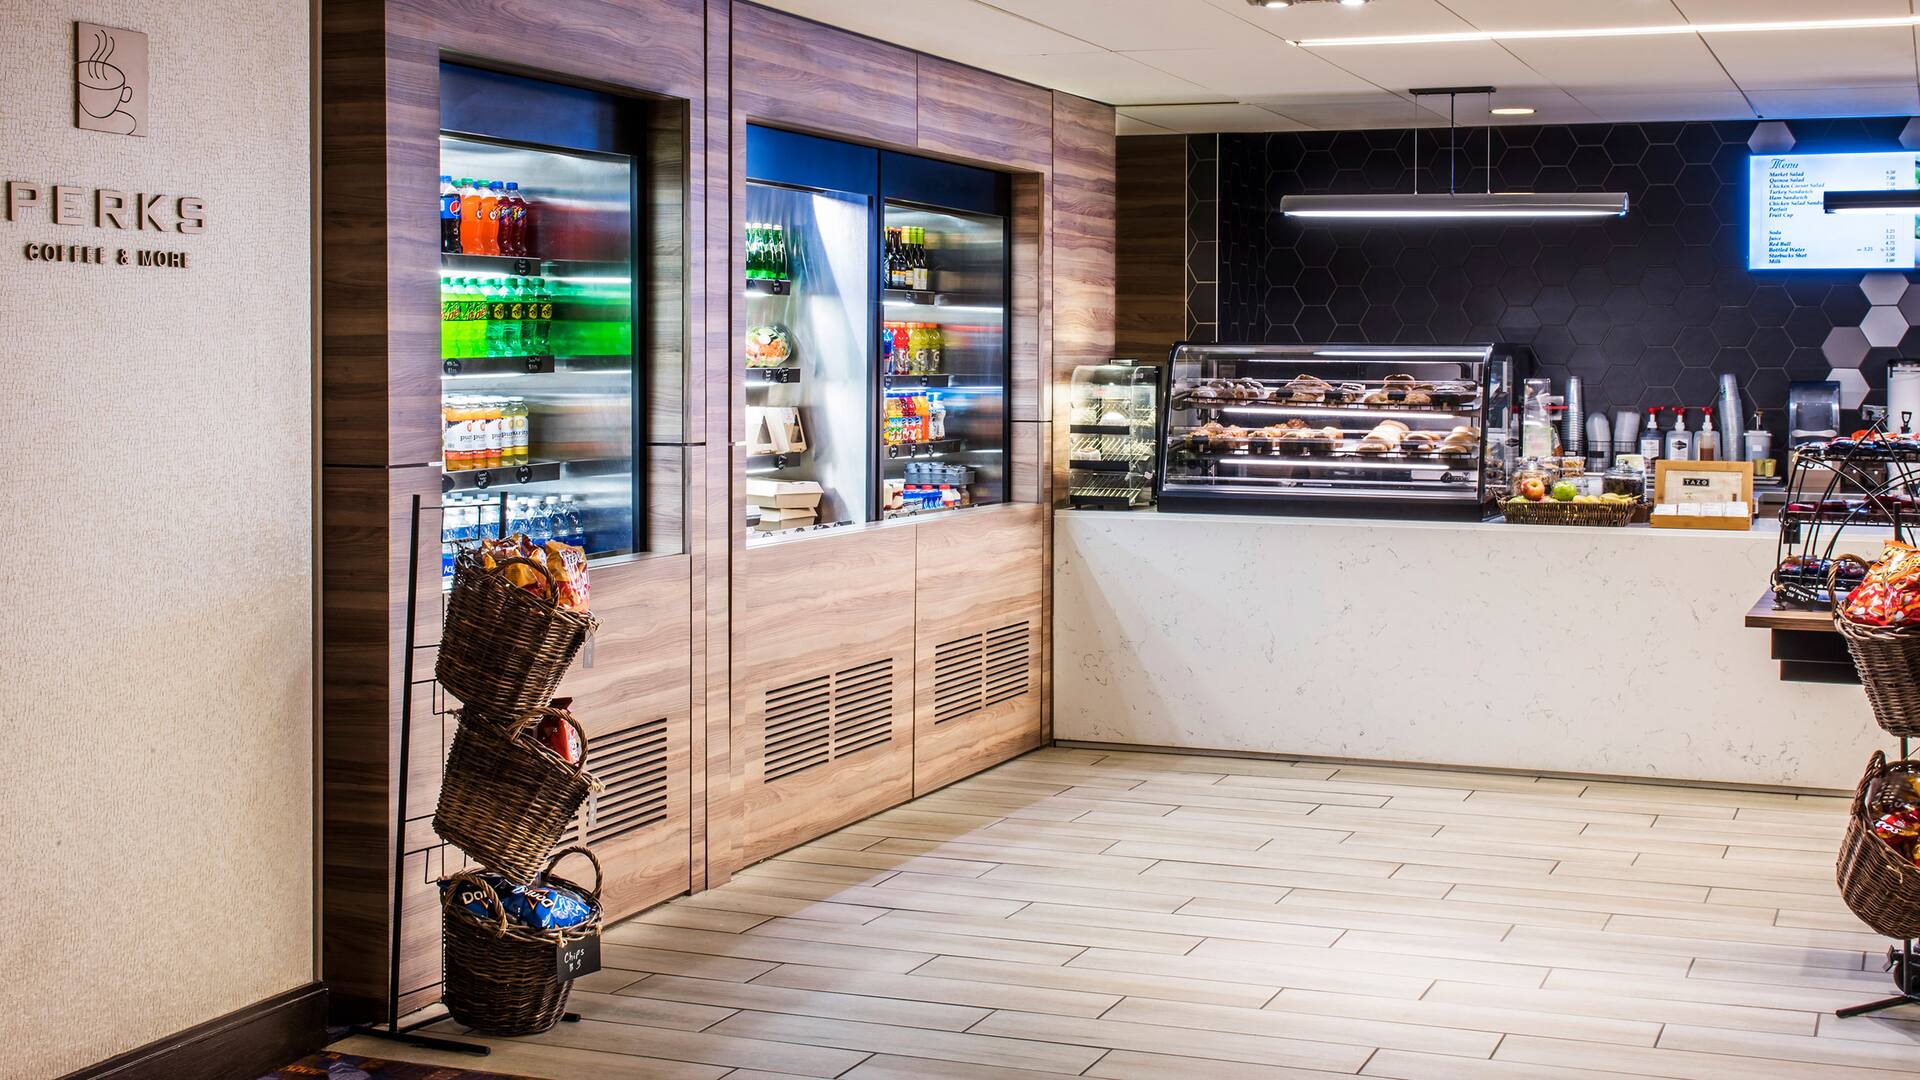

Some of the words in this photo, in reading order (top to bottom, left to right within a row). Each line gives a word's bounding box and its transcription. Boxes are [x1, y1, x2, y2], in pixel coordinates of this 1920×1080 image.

[1769, 158, 1799, 169] Menu
[6, 181, 208, 234] PERKS
[25, 243, 106, 264] COFFEE
[118, 248, 129, 266] &
[138, 250, 191, 268] MORE
[564, 948, 585, 964] Chips
